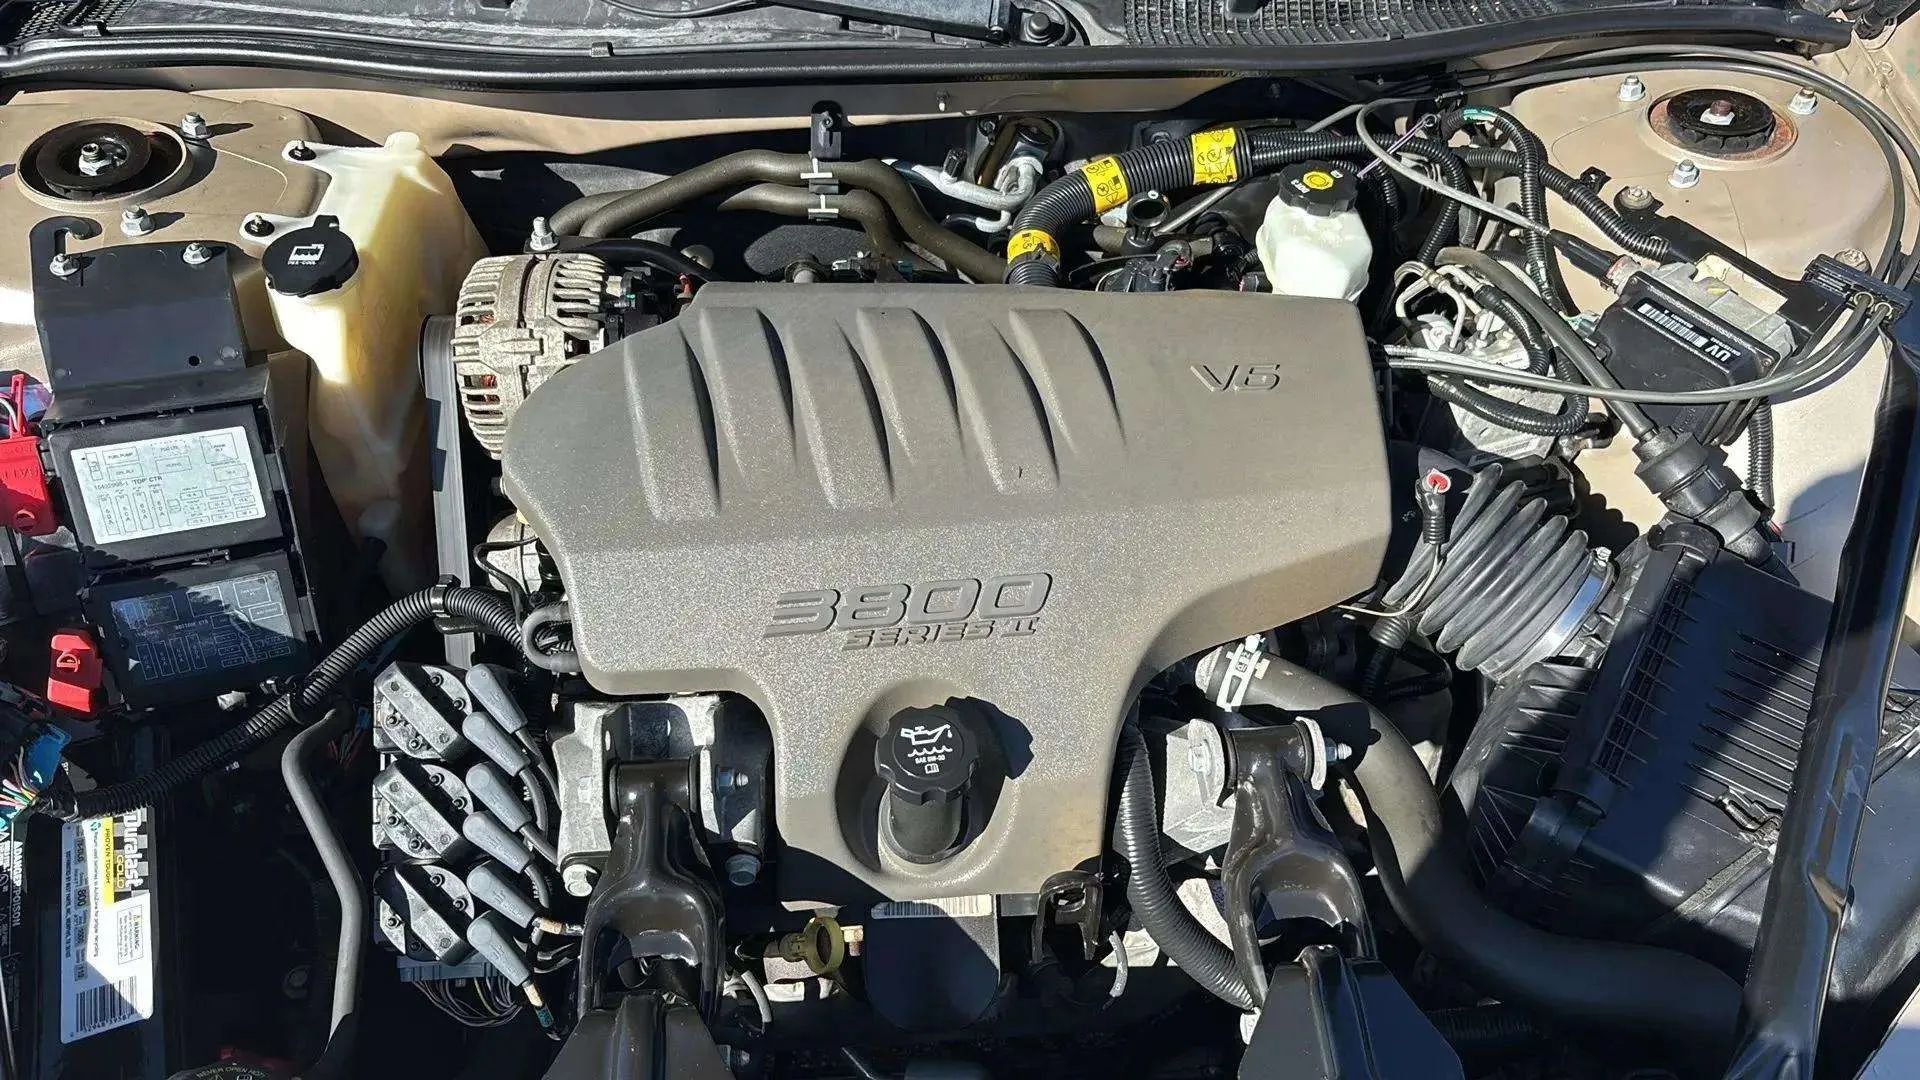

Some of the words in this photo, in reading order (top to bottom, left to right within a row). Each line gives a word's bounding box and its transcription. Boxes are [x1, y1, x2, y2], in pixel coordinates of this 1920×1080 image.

[1705, 344, 1731, 361] UV
[1190, 364, 1280, 391] V6
[763, 572, 1054, 638] 3800
[842, 620, 995, 650] SERIES
[124, 811, 143, 888] Duralast
